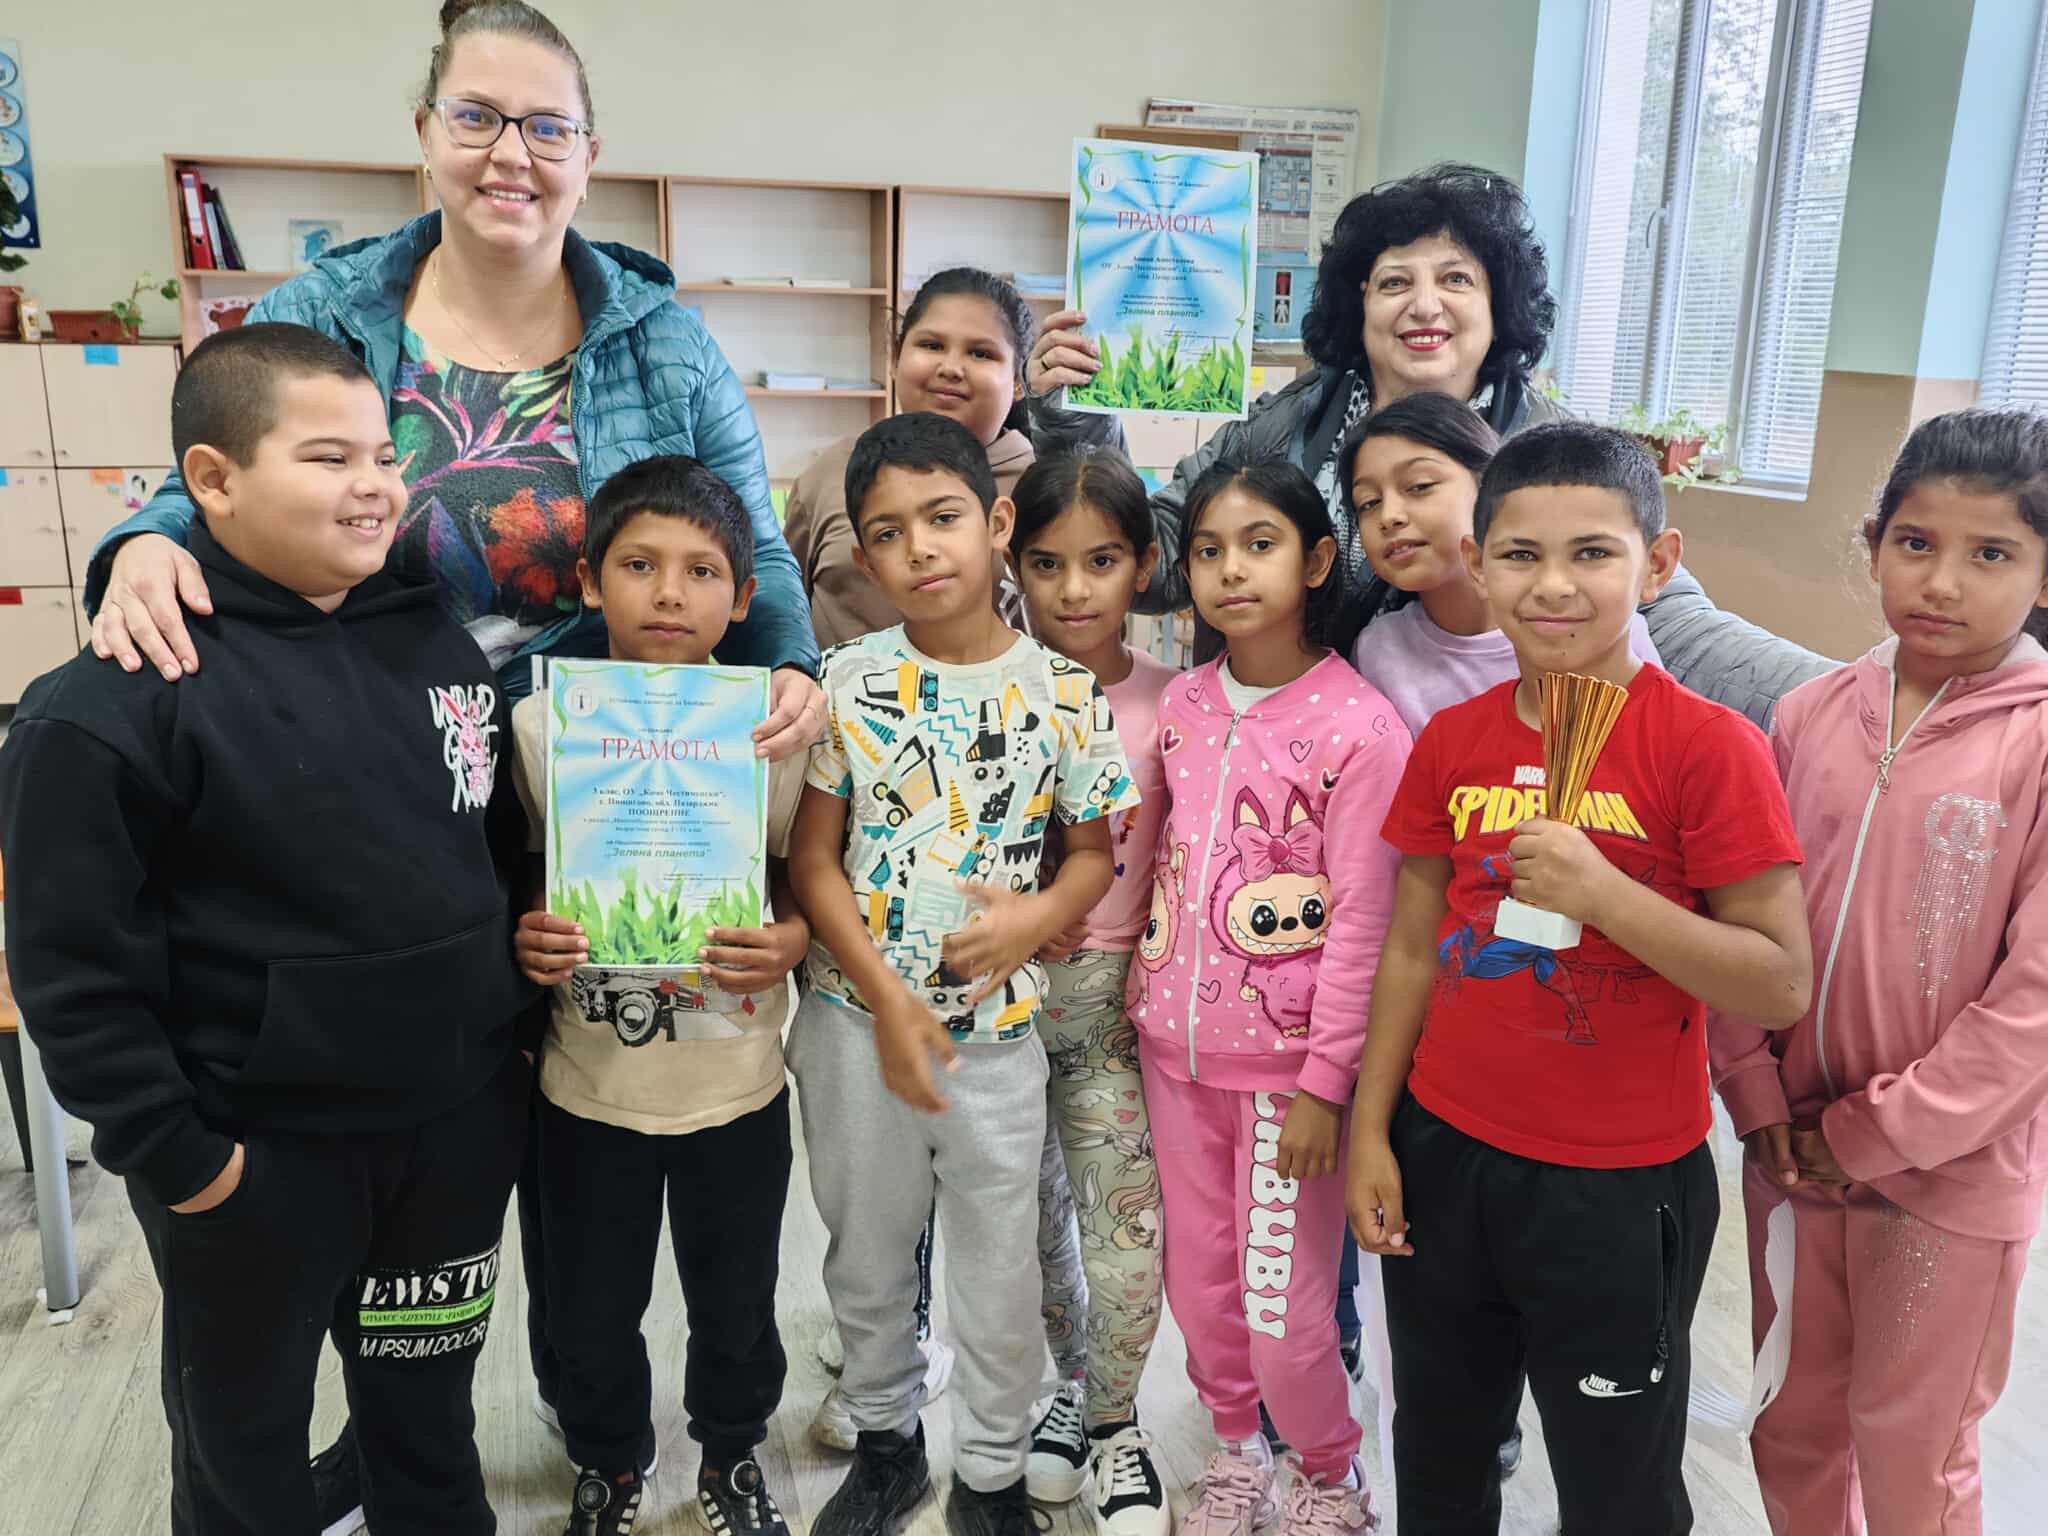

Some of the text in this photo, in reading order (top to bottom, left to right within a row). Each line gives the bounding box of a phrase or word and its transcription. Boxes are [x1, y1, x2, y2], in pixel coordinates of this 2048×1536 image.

[1117, 211, 1215, 235] ГРАМОТА
[600, 738, 721, 761] ГРАМОТА
[1588, 1373, 1619, 1393] NIKE
